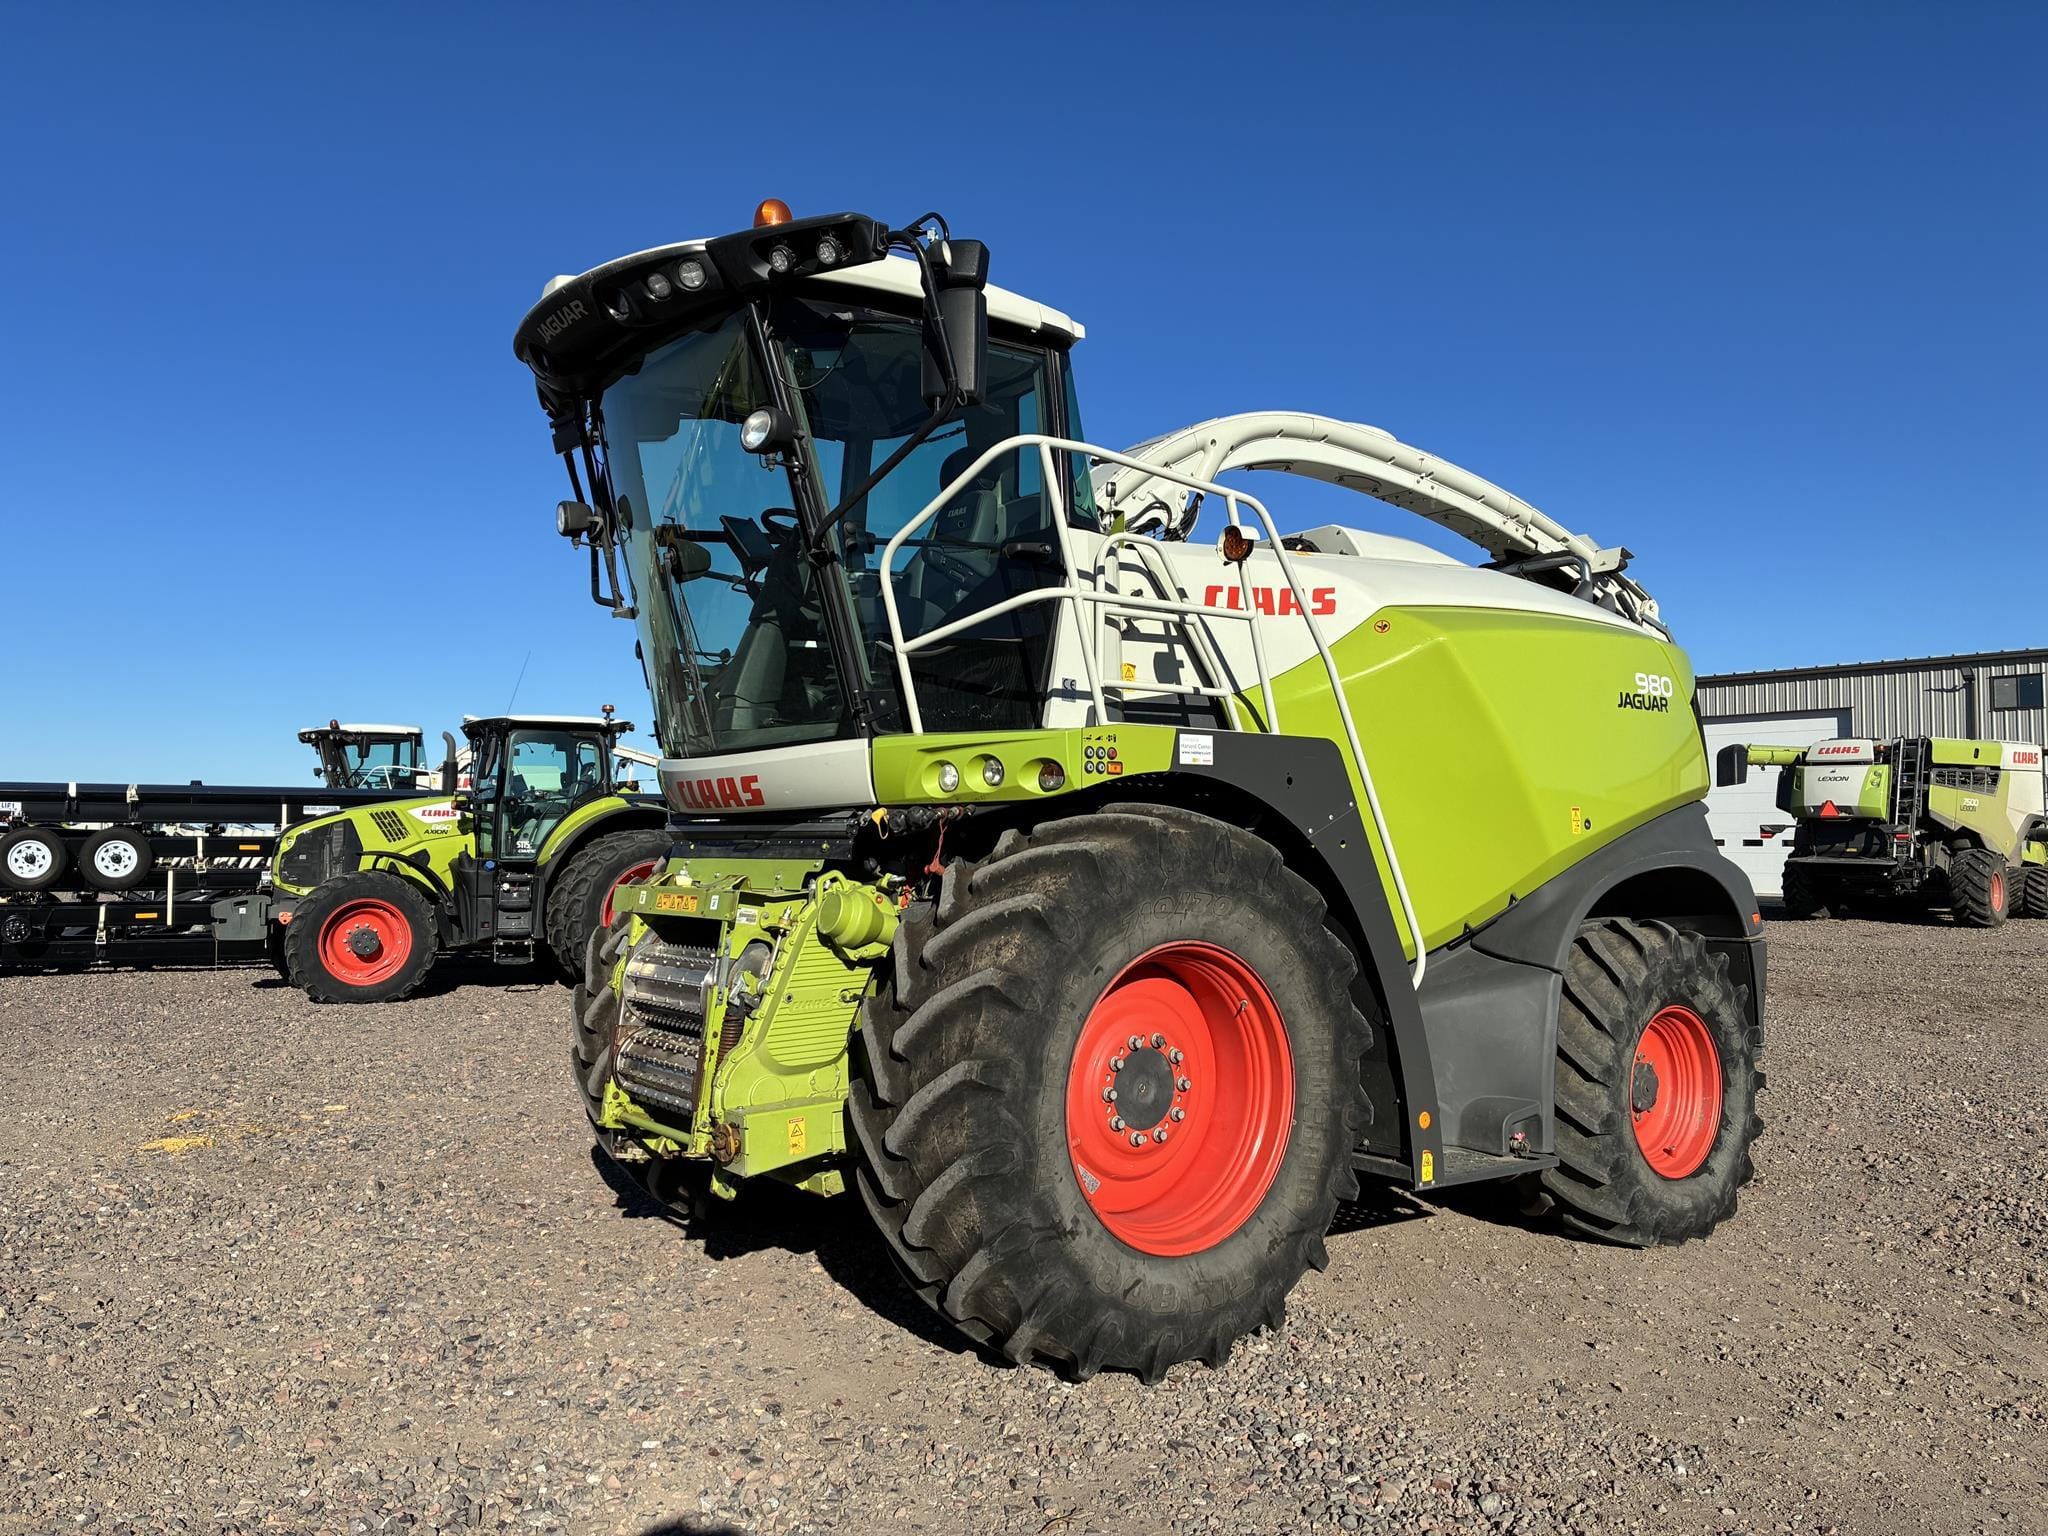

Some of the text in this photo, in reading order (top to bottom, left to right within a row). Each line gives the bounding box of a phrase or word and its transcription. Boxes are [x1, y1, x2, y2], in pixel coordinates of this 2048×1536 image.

[1204, 585, 1336, 616] CLAAS
[1635, 672, 1673, 698] 980
[1618, 691, 1669, 713] JAGUAR
[1817, 746, 1861, 755] CLAAS
[2013, 751, 2039, 765] CLAAS
[675, 775, 766, 809] CLAAS
[421, 809, 457, 817] CLAAS
